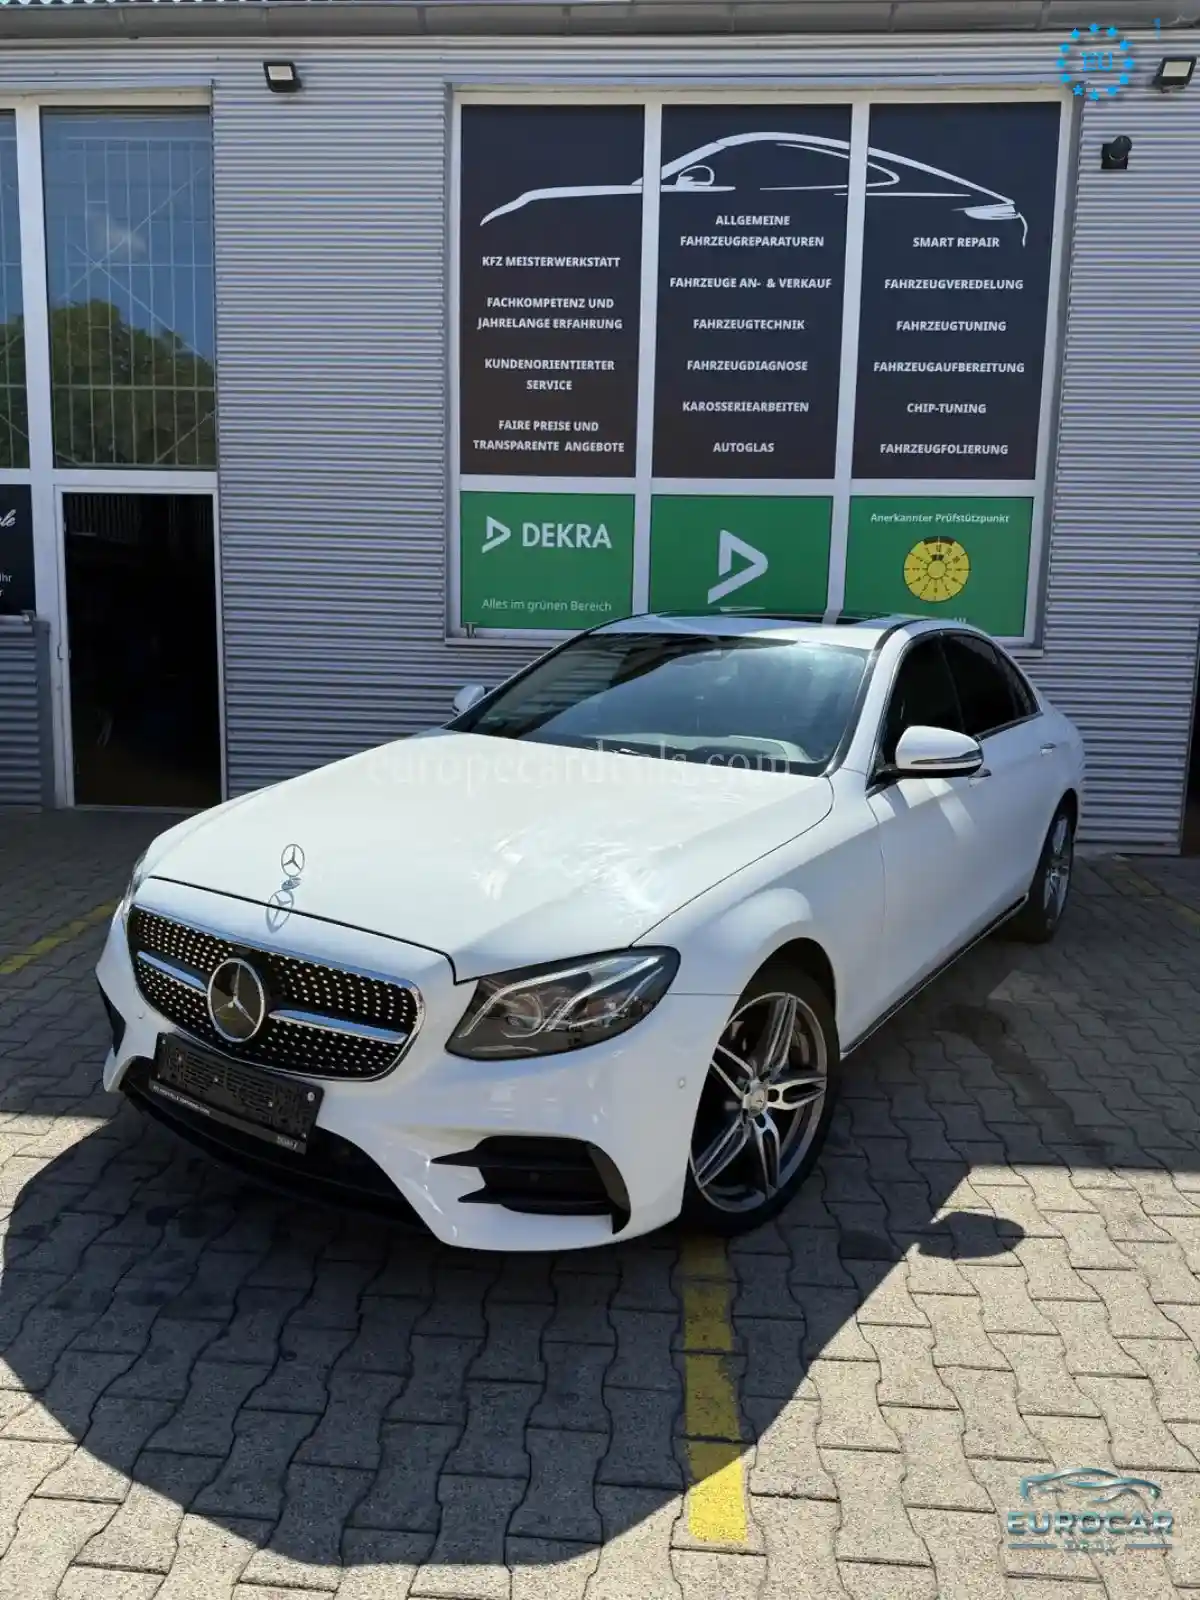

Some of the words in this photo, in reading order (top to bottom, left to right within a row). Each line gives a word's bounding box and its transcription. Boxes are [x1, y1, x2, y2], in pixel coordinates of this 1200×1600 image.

[716, 215, 790, 226] ALLGEMEINE
[680, 236, 824, 247] FAHRZEUGREPARATUREN
[913, 237, 954, 247] SMART
[957, 237, 1000, 248] REPAIR
[482, 256, 502, 267] KFZ
[505, 256, 620, 268] MEISTERWERKSTATT
[670, 277, 737, 288] FAHRZEUGE
[739, 278, 762, 288] AN-
[766, 278, 775, 288] &
[779, 278, 832, 289] VERKAUF
[884, 279, 1024, 290] FAHRZEUGVEREDELUNG
[487, 297, 585, 309] FACHKOMPETENZ
[588, 298, 614, 309] UND
[477, 318, 550, 330] JAHRELANGE
[553, 318, 623, 330] ERFAHRUNG
[693, 319, 805, 330] FAHRZEUGTECHNIK
[896, 321, 1007, 332] FAHRZEUGTUNING
[484, 359, 615, 371] KUNDENORIENTIERTER
[687, 360, 808, 371] FAHRZEUGDIAGNOSE
[873, 362, 1025, 373] FAHRZEUGAUFBEREITUNG
[526, 380, 572, 390] SERVICE
[682, 401, 809, 412] KAROSSERIEARBEITEN
[907, 403, 987, 414] CHIP-TUNING
[498, 420, 531, 431] FAIRE
[533, 420, 570, 431] PREISE
[573, 421, 599, 432] UND
[473, 440, 559, 451] TRANSPARENTE
[564, 441, 625, 452] ANGEBOTE
[713, 442, 775, 453] AUTOGLAS
[880, 444, 1009, 455] FAHRZEUGFOLIERUNG
[870, 513, 933, 523] Anerkannter
[935, 513, 1011, 524] Prüfstützpunkt
[522, 522, 613, 549] DEKRA
[481, 598, 508, 610] Alles
[510, 600, 524, 609] im
[527, 599, 567, 613] grünen
[571, 600, 612, 612] Bereich
